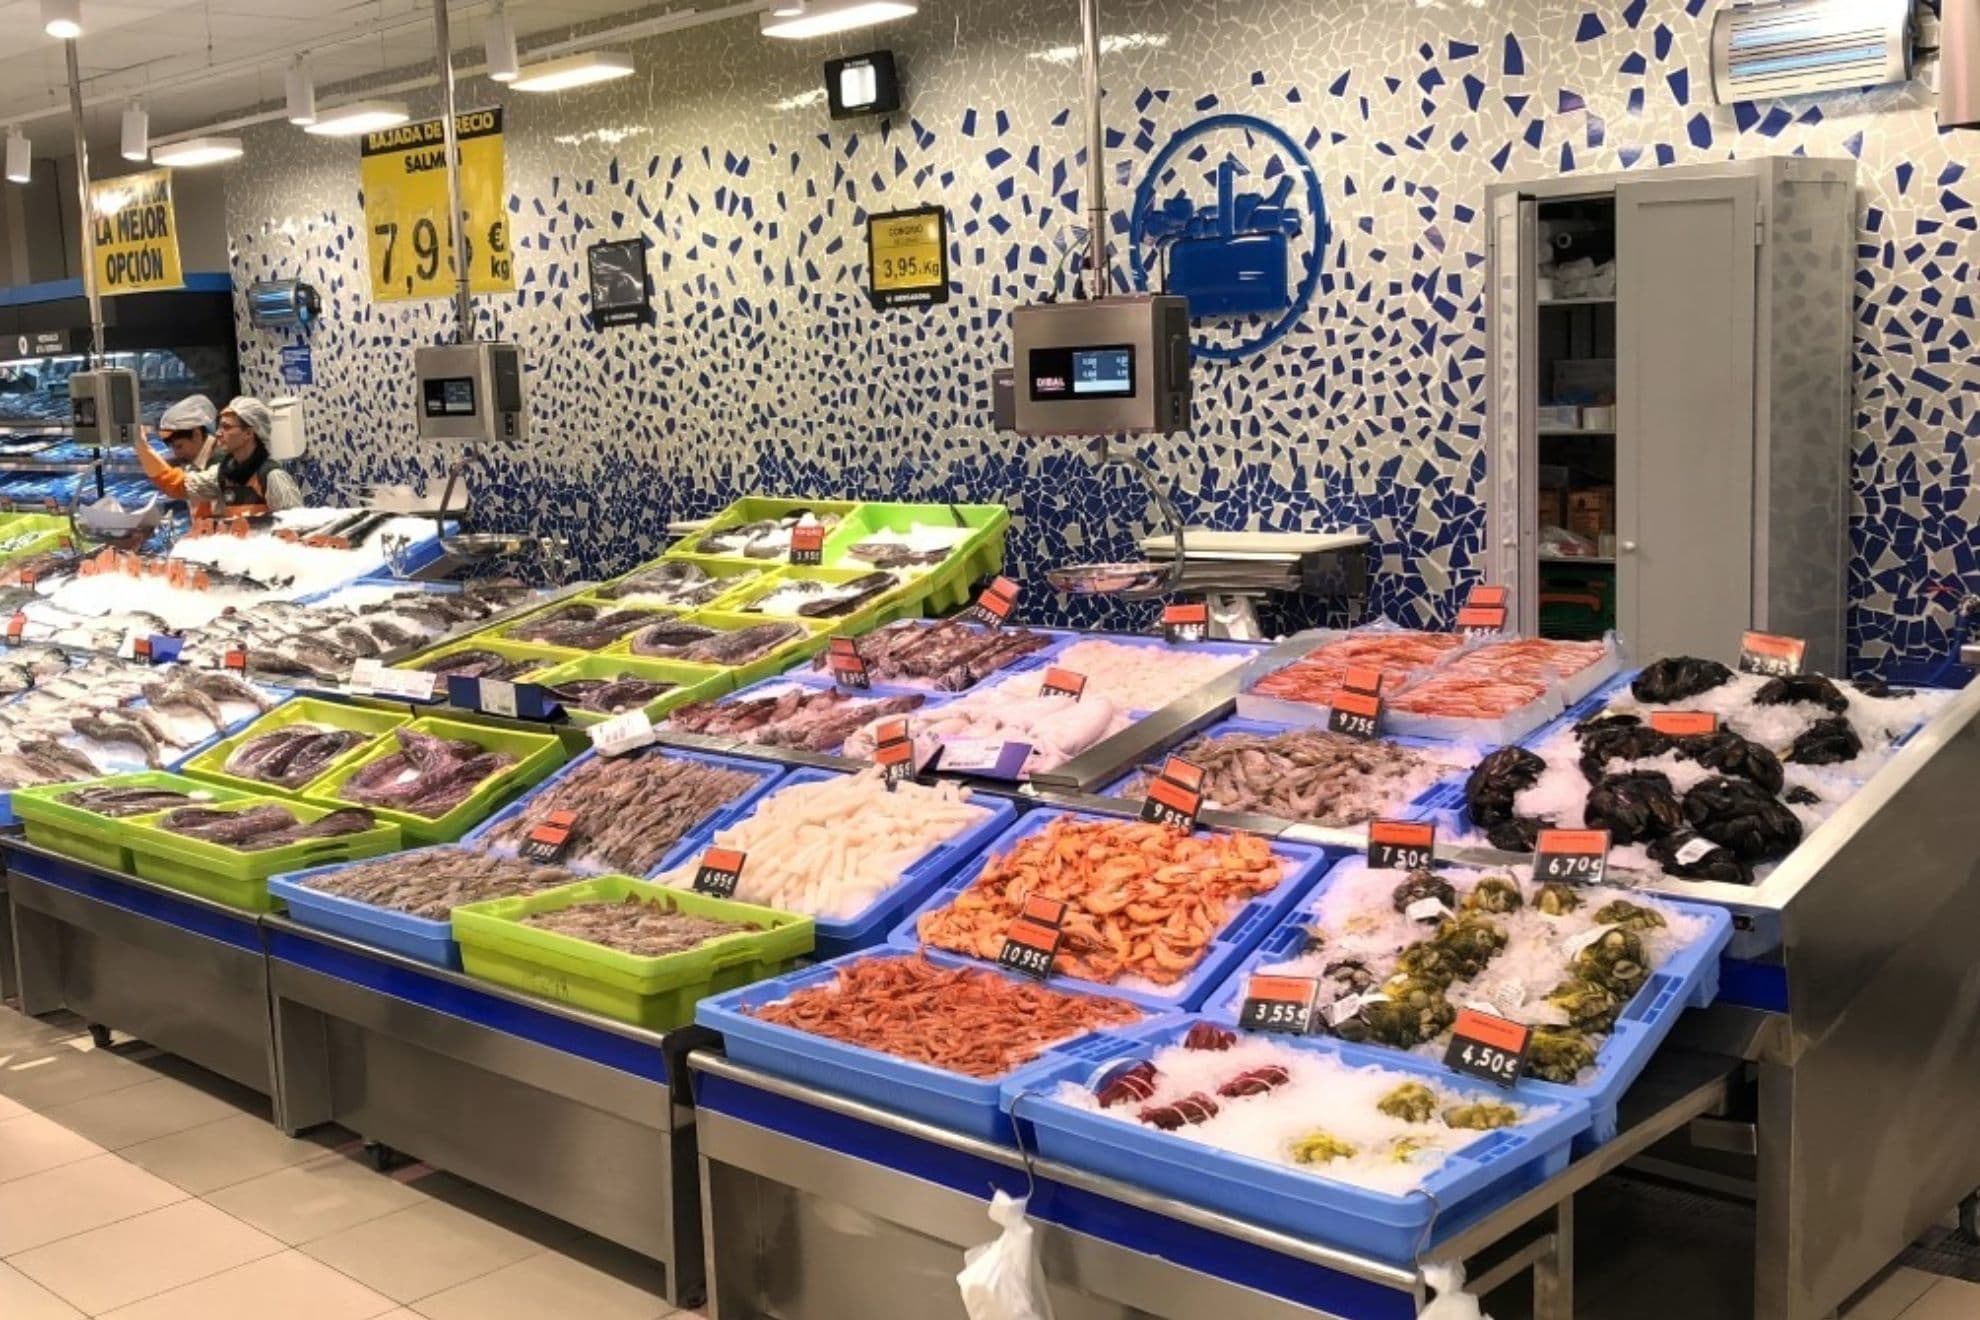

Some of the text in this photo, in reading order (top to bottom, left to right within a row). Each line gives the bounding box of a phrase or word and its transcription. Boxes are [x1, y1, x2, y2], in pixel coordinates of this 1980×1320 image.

[369, 113, 495, 150] BAJADA DE RECIO
[404, 147, 463, 174] SALM
[95, 204, 169, 246] LA MEJOR
[488, 221, 504, 252] €
[106, 242, 164, 285] OPCIÓN
[491, 255, 511, 281] kg
[1461, 1044, 1518, 1078] 4,50€
